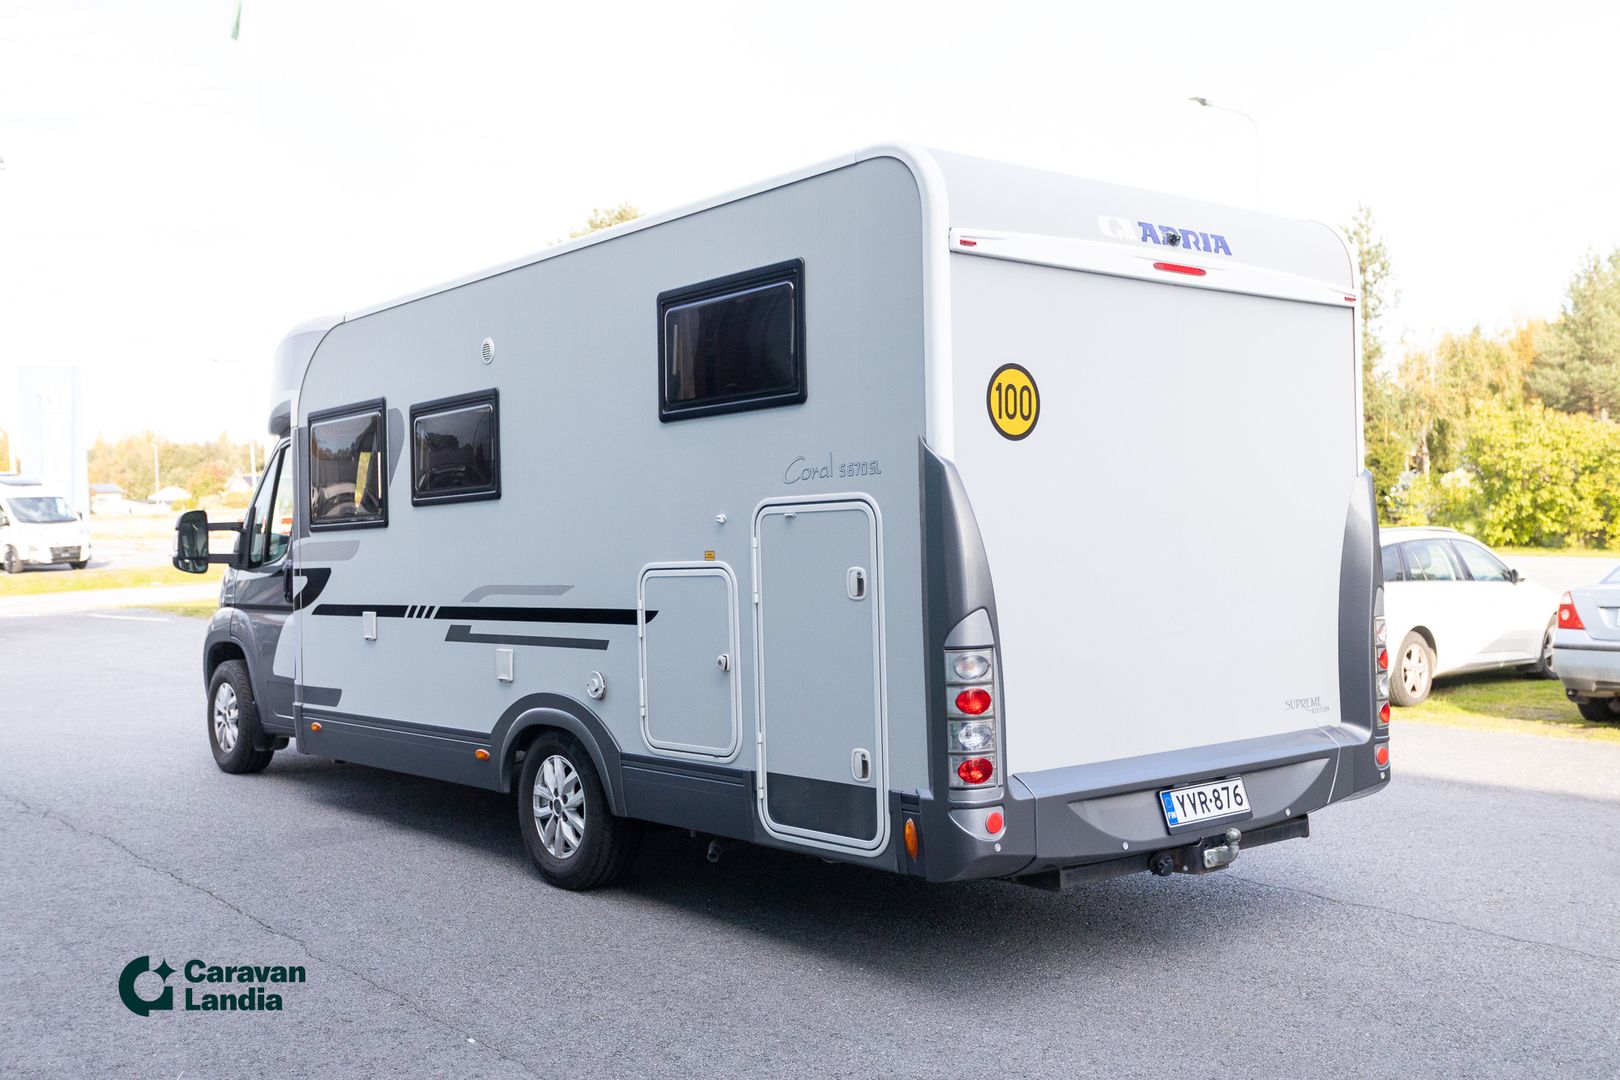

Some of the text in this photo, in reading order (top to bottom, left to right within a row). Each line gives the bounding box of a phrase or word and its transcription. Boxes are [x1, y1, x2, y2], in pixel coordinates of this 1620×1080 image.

[995, 382, 1032, 422] 100
[783, 452, 833, 485] Coral
[1175, 784, 1244, 818] YVR-876
